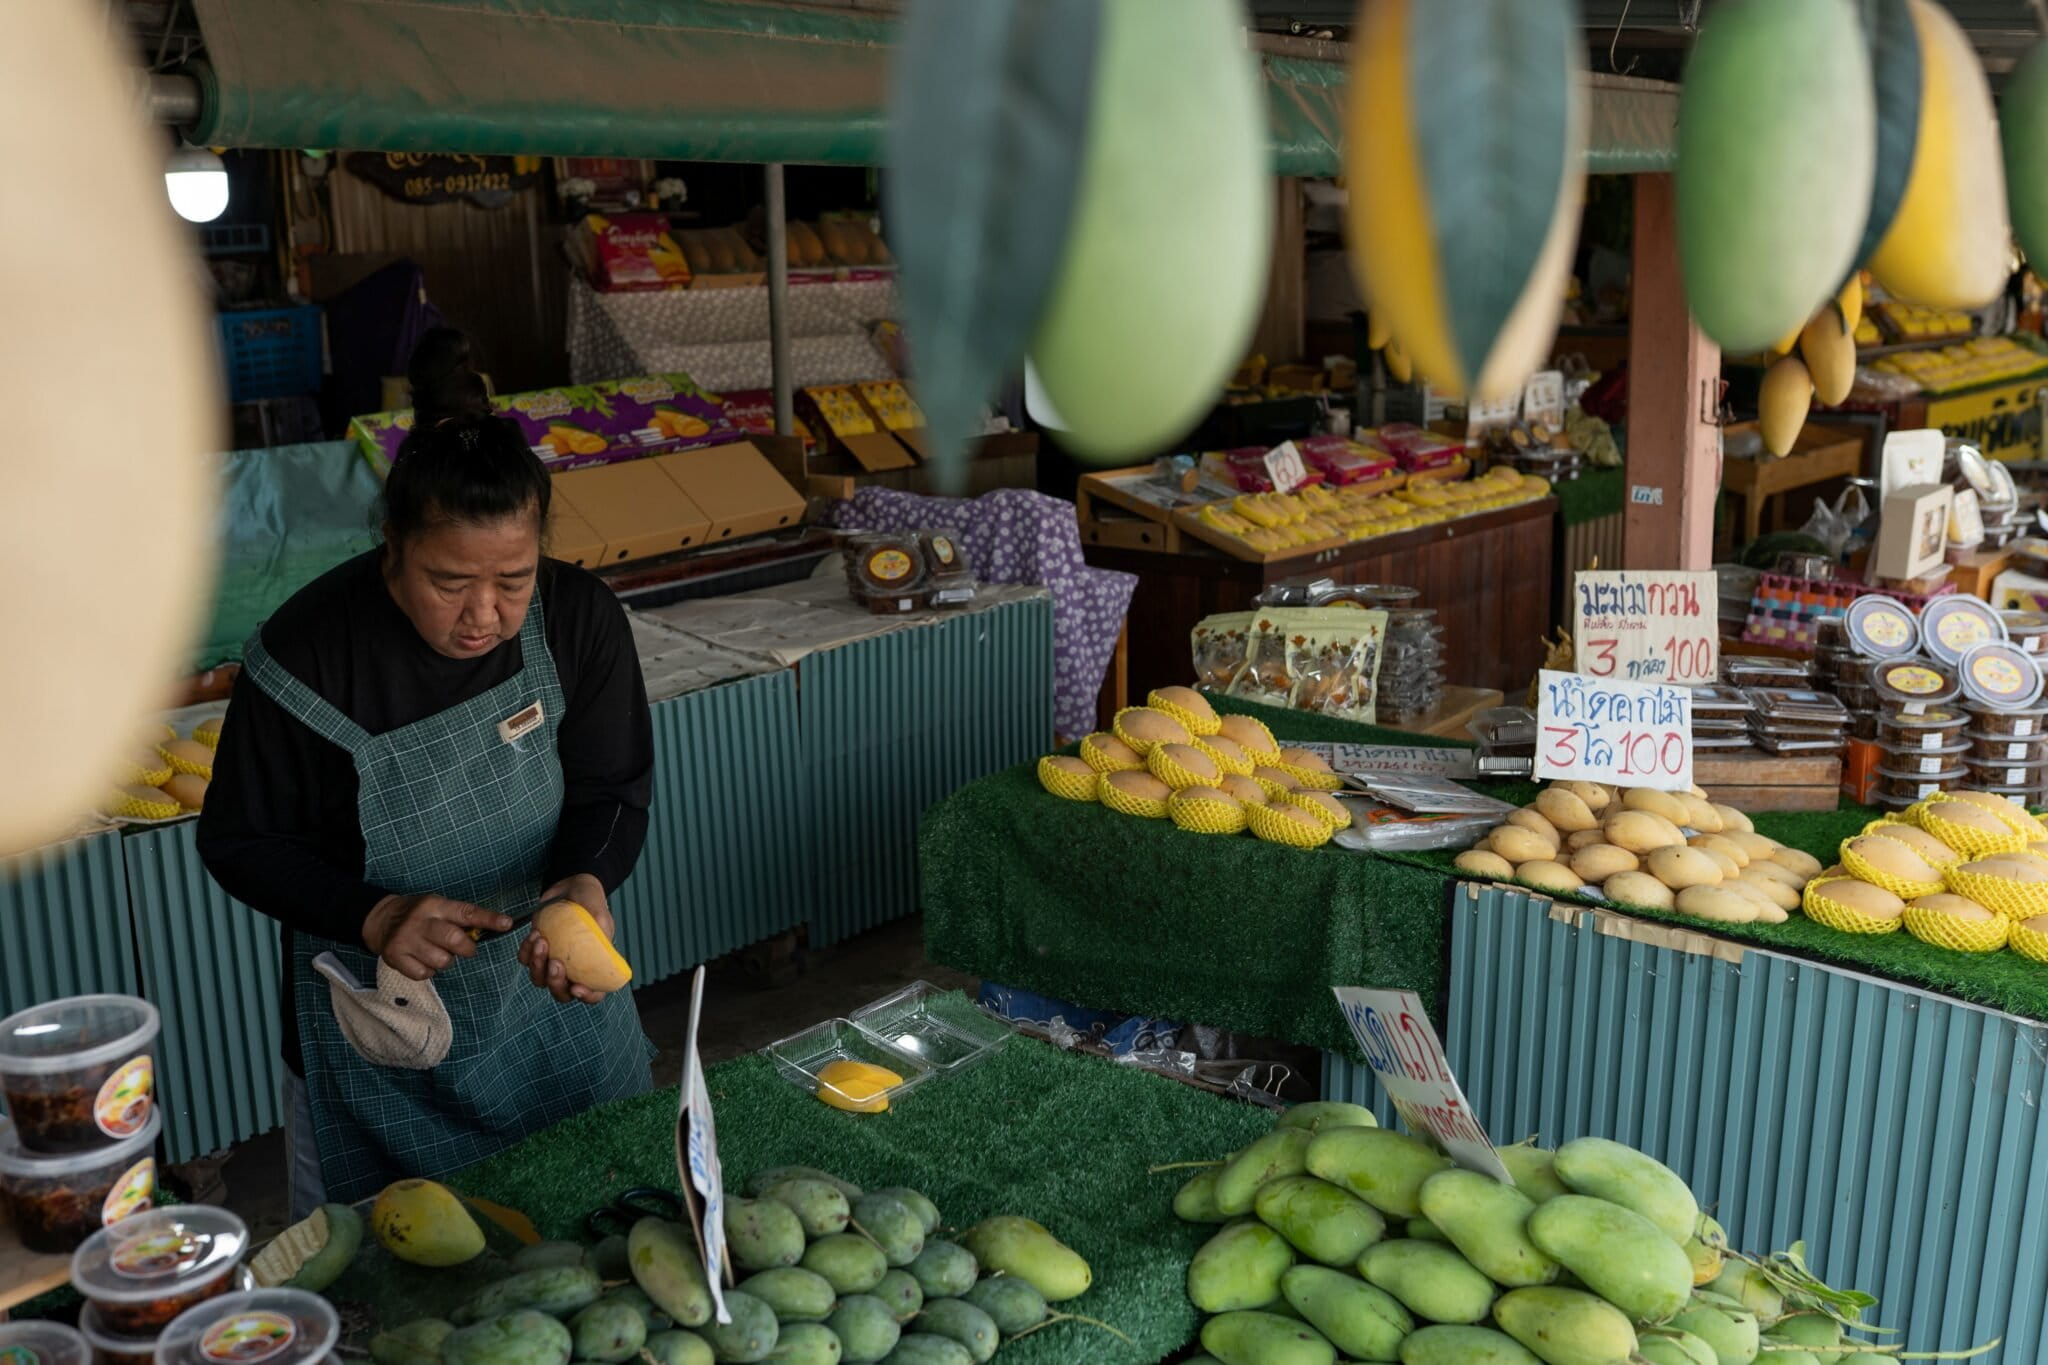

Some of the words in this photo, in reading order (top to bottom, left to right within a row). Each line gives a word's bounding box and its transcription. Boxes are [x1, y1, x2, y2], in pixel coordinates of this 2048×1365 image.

[1587, 639, 1619, 676] 3
[1626, 647, 1666, 680] กล่อง
[1544, 726, 1579, 767] 3
[1572, 722, 1613, 766] โล
[1617, 730, 1684, 776] 100
